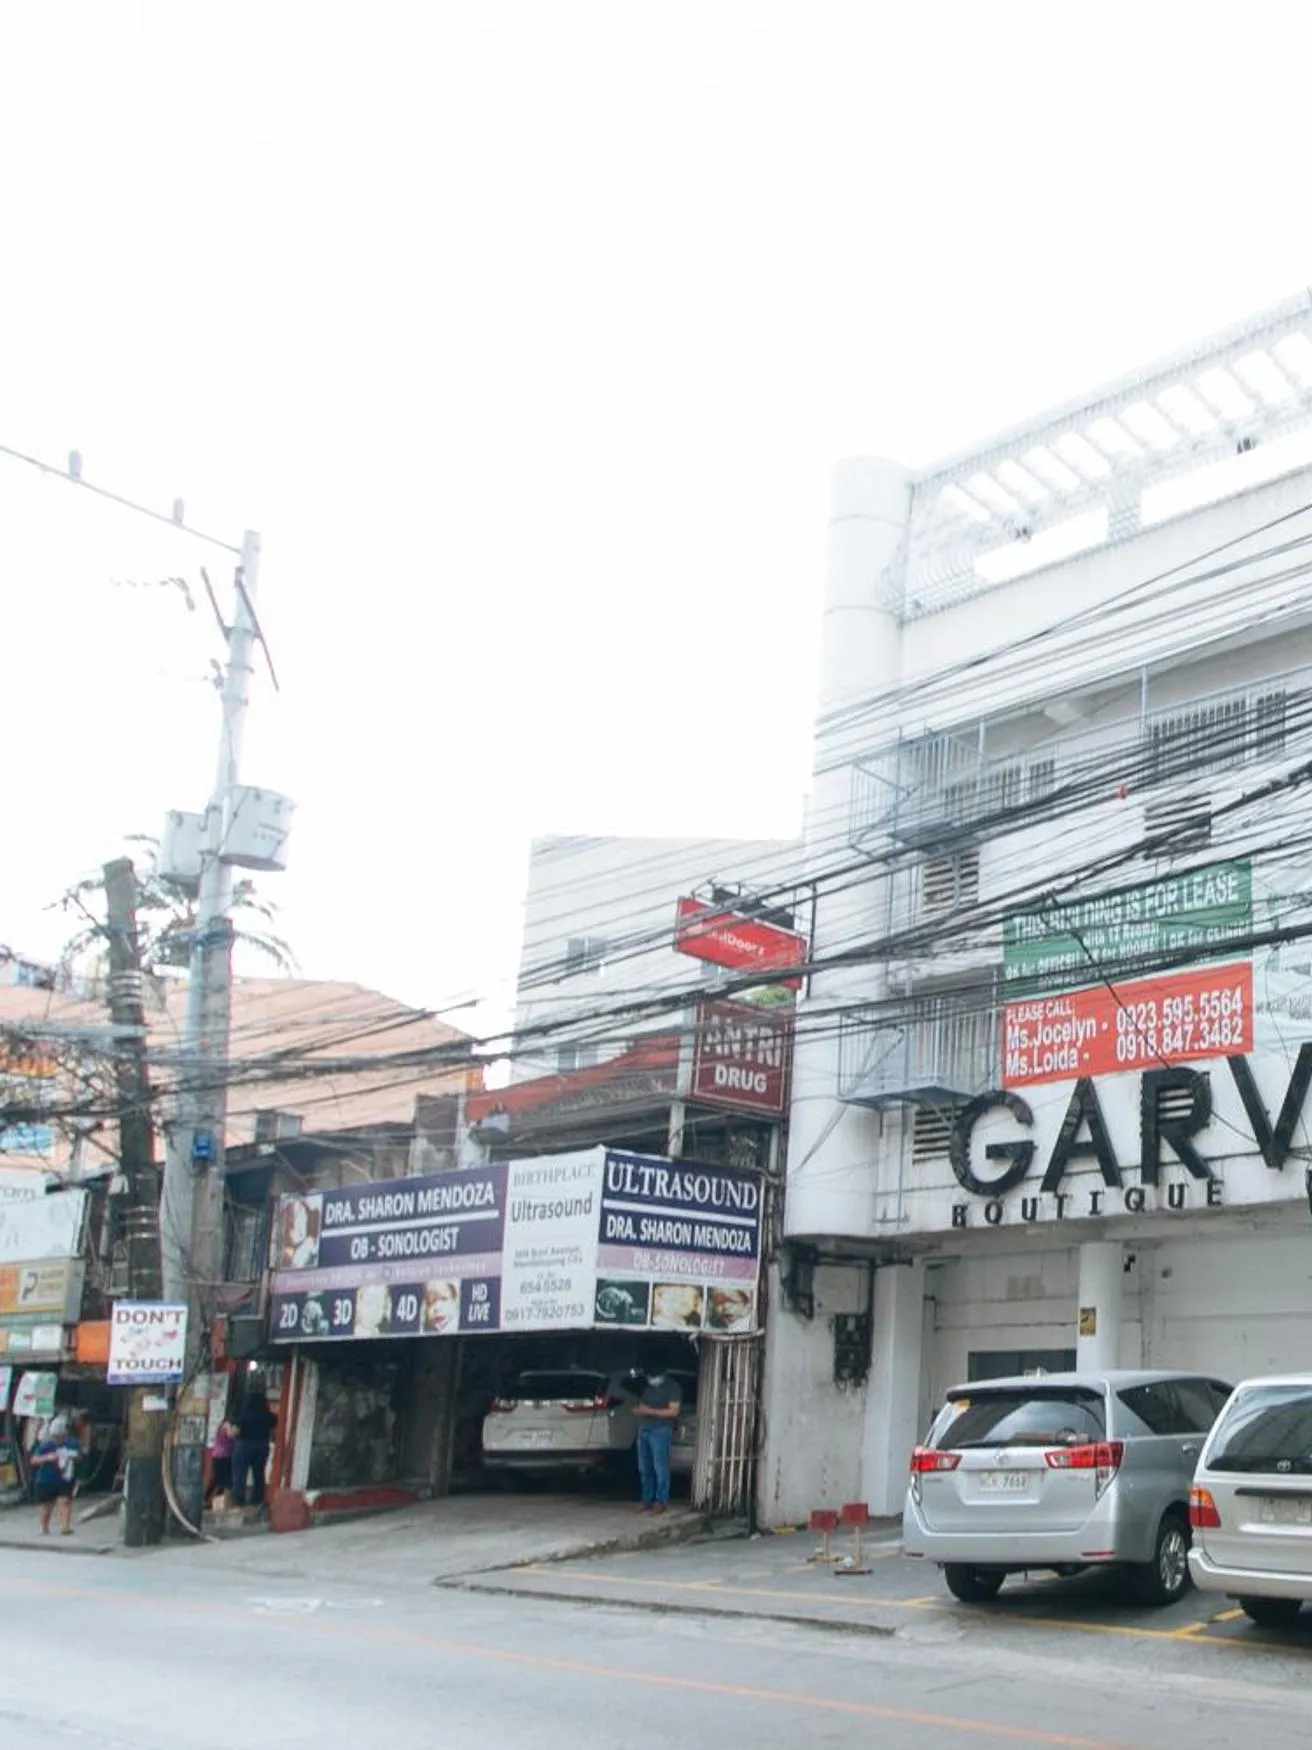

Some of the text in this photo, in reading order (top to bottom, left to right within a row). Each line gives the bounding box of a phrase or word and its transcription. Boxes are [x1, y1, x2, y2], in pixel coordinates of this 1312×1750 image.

[1145, 881, 1179, 918] FOR
[1183, 871, 1239, 909] LEASE
[706, 927, 765, 957] edDoorz
[1006, 1007, 1043, 1024] PLEASE
[1006, 1015, 1097, 1049] Ms.Jocelyn
[1115, 984, 1243, 1032] 0923.595.5564
[1005, 1046, 1079, 1077] Ms.Loida
[714, 1063, 768, 1095] DRUG
[513, 1163, 596, 1188] BIRTHPLACE
[607, 1160, 757, 1210] ULTRASOUND
[325, 1181, 495, 1225] DRA. SHARON MENDOZA
[511, 1191, 592, 1223] Ultrasound
[951, 1178, 1225, 1228] BOUTIQUE
[351, 1237, 369, 1259] OB
[377, 1227, 459, 1256] SONOLOGIST
[606, 1215, 752, 1252] DRA. SHARON MENDOZA
[116, 1309, 185, 1325] DON'T
[279, 1282, 488, 1328] 2D 3D 4D HD
[468, 1303, 490, 1322] LIVE
[115, 1357, 183, 1371] TOUCH
